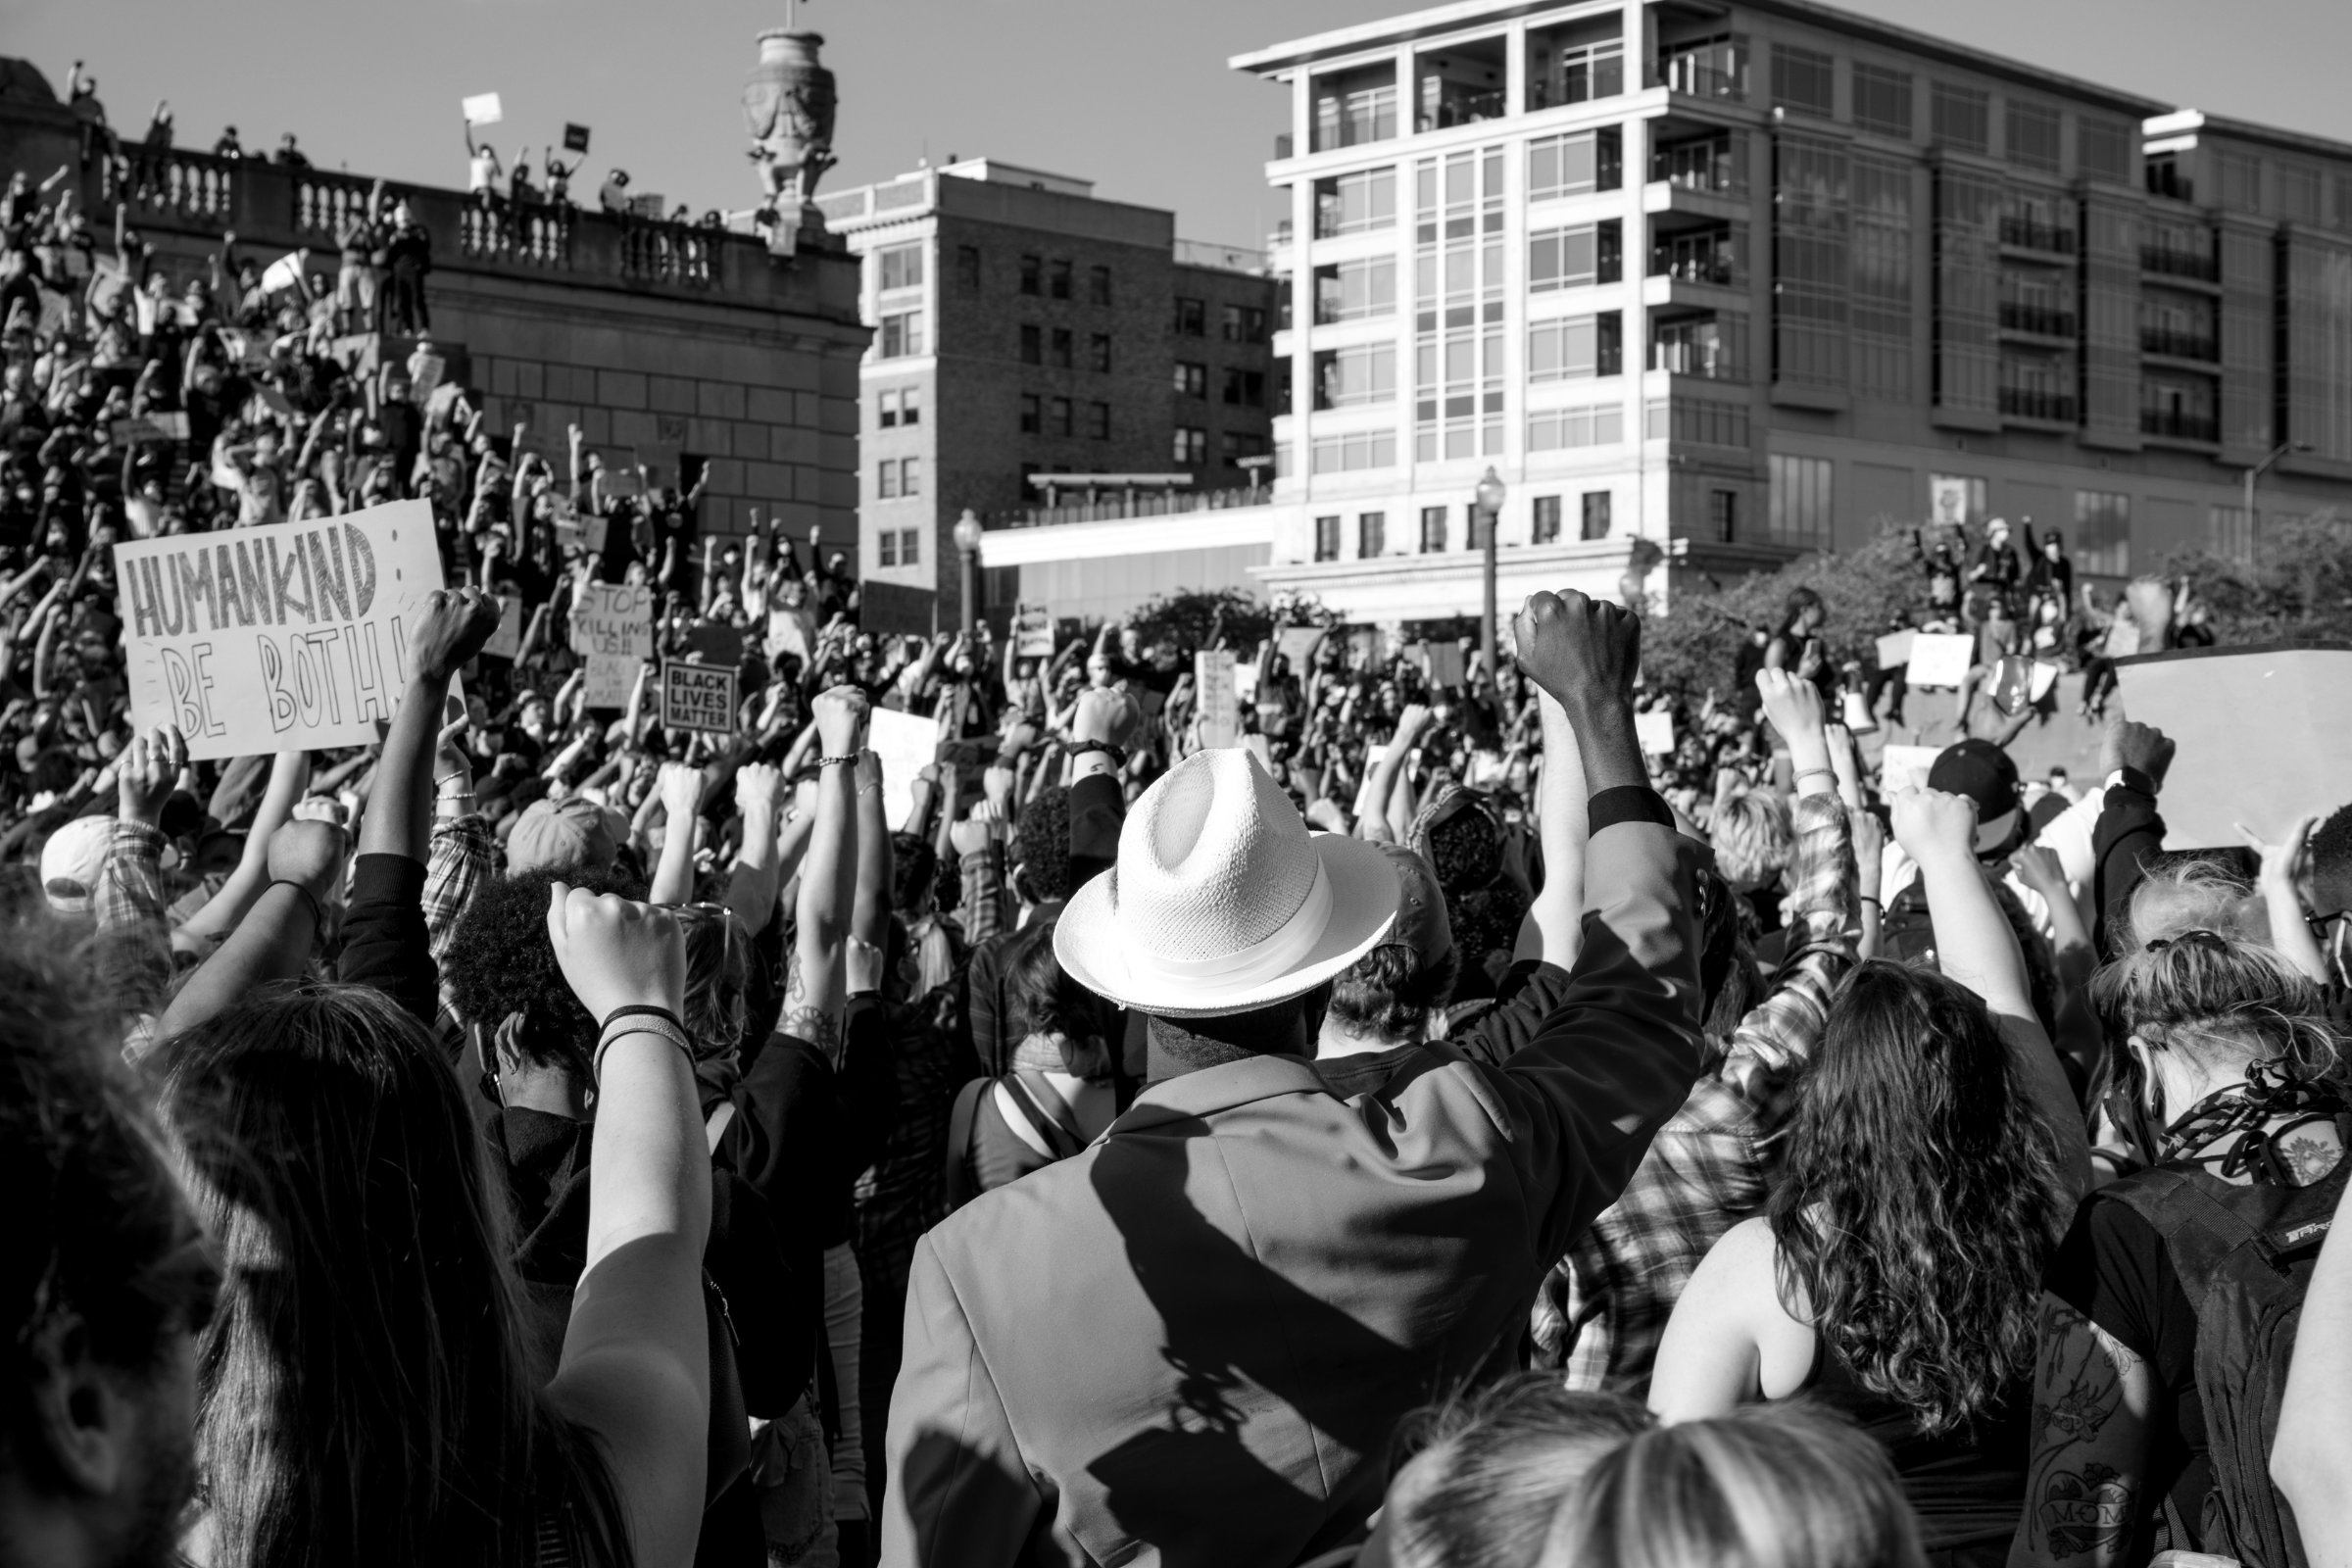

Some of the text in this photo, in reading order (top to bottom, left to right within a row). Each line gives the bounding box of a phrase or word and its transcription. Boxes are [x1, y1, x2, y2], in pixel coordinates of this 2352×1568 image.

[574, 586, 649, 614] STOP
[574, 616, 649, 637] KILLING
[671, 669, 727, 691] BLACK
[161, 642, 227, 743] BE
[670, 687, 728, 710] LIVES
[670, 707, 727, 726] MATTER
[2049, 1501, 2127, 1525] MOM
